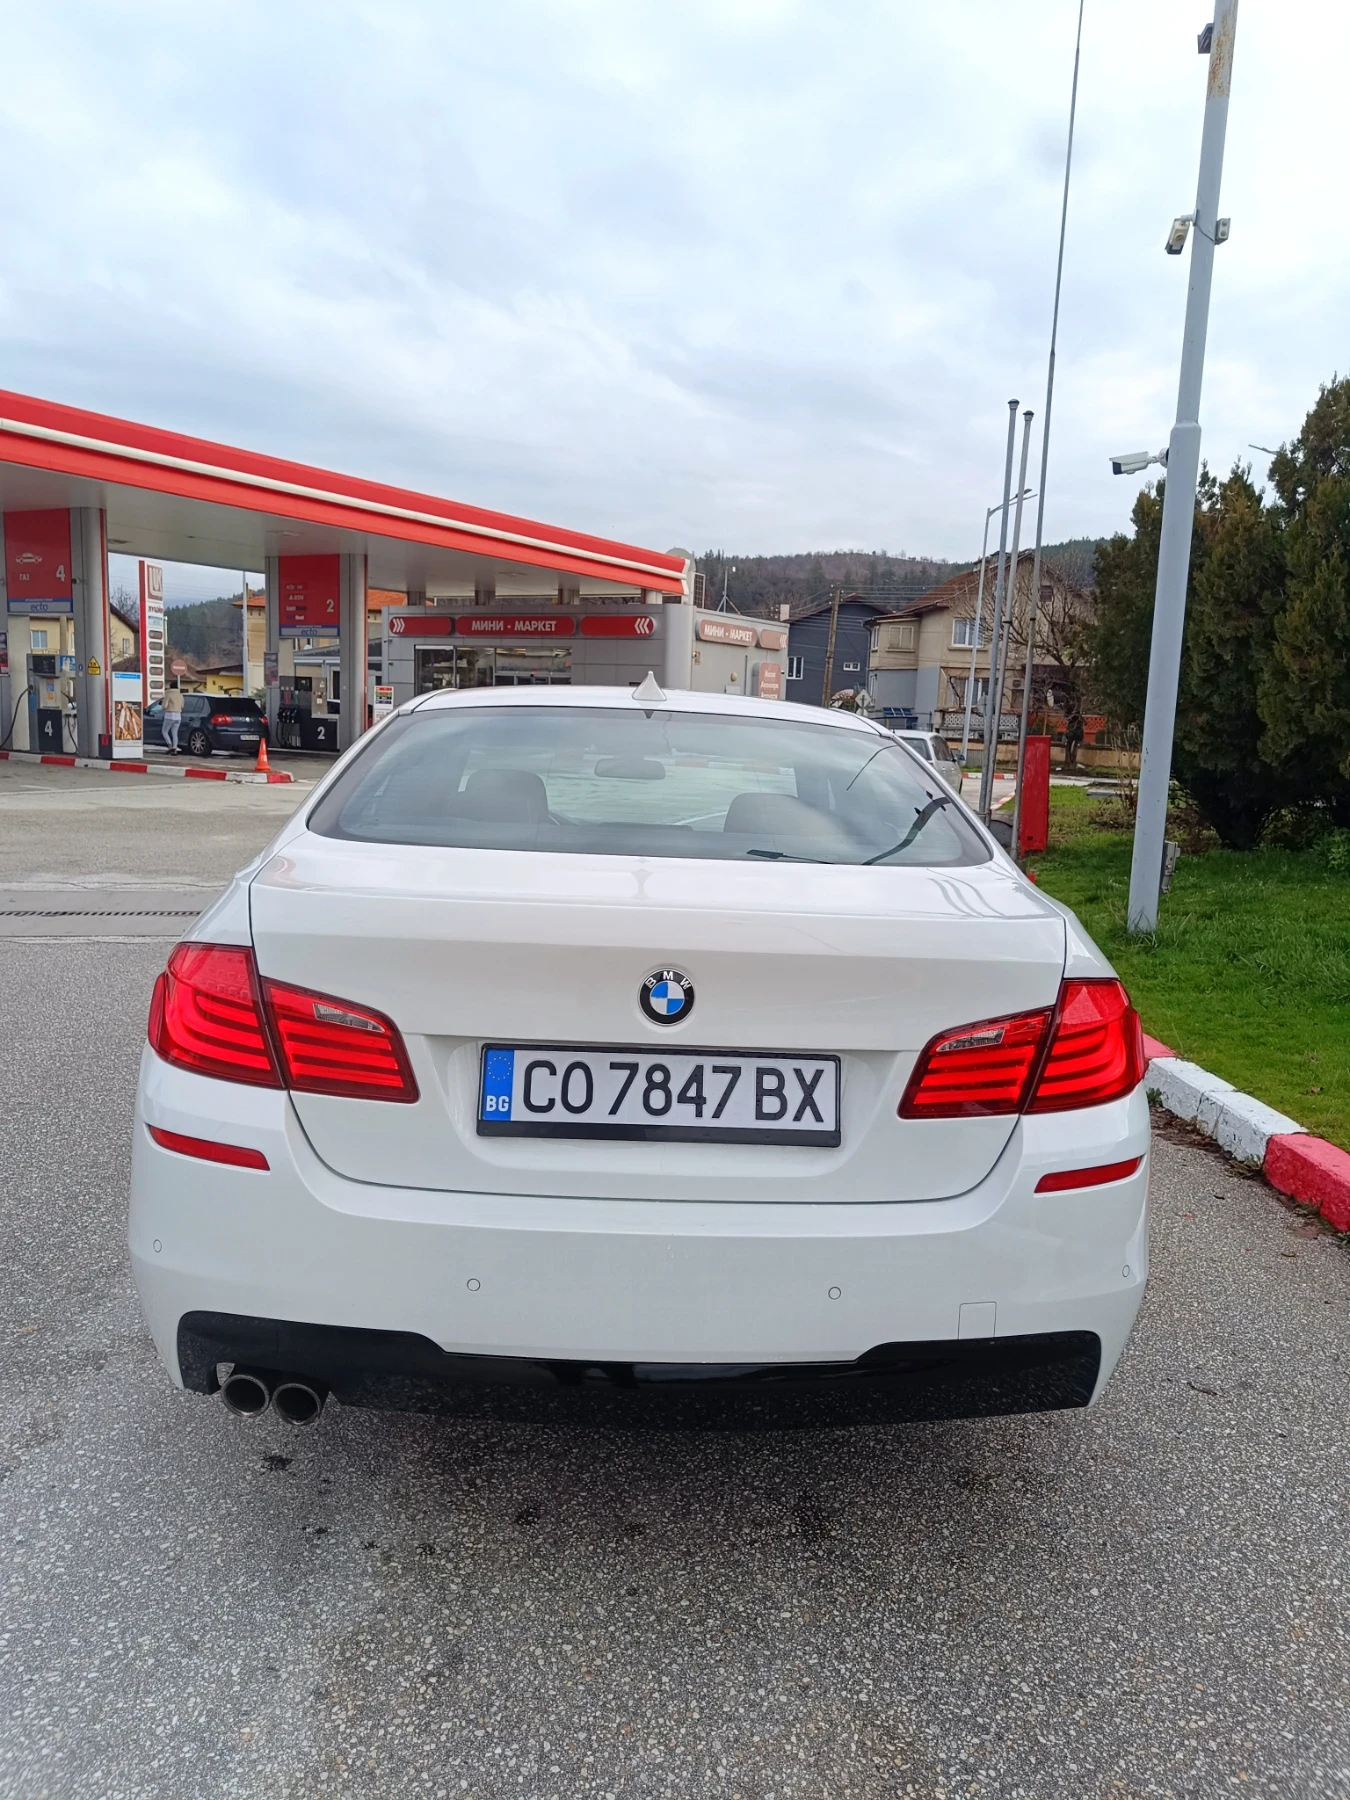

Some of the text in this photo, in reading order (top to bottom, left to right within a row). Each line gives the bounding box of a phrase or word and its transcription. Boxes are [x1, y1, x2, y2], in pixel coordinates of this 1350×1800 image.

[19, 573, 30, 581] ГАЗ
[55, 565, 66, 582] 4
[30, 602, 48, 612] ecto
[326, 599, 335, 612] 2
[301, 628, 318, 636] ecto
[471, 620, 504, 631] МИНИ
[514, 620, 557, 632] МАРКЕТ
[703, 623, 725, 639] МИНИ
[729, 628, 753, 643] МАРКЕТ
[44, 720, 53, 737] 4
[317, 726, 326, 740] 2
[644, 970, 692, 990] BMW
[607, 1061, 742, 1120] 7847
[755, 1066, 825, 1123] BX
[485, 1095, 510, 1112] BG
